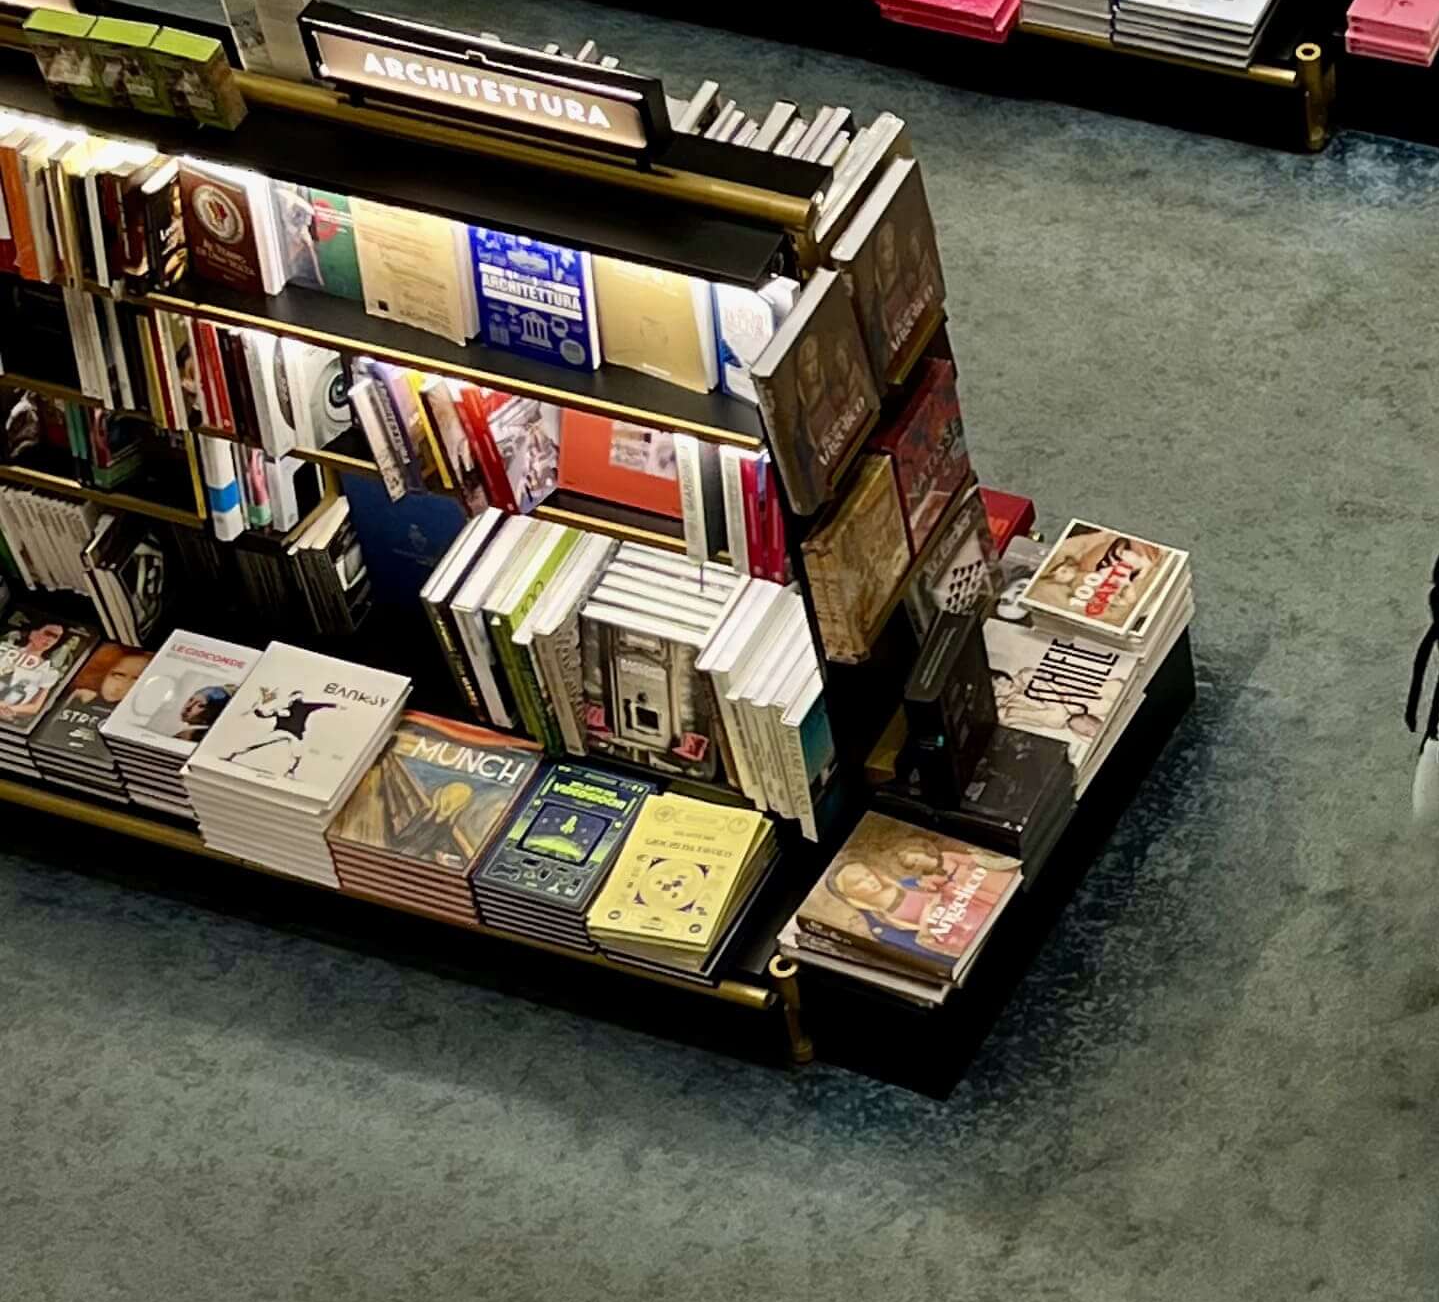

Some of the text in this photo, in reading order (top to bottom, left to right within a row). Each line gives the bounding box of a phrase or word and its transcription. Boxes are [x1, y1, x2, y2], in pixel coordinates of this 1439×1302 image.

[362, 51, 612, 129] ARCHITETTURA
[482, 272, 583, 313] ARCHITETTURA
[1068, 570, 1102, 608] 100
[1085, 561, 1134, 619] GATTI
[323, 682, 391, 709] BANKSY
[412, 737, 526, 786] MUNCH
[930, 866, 988, 943] Angelico
